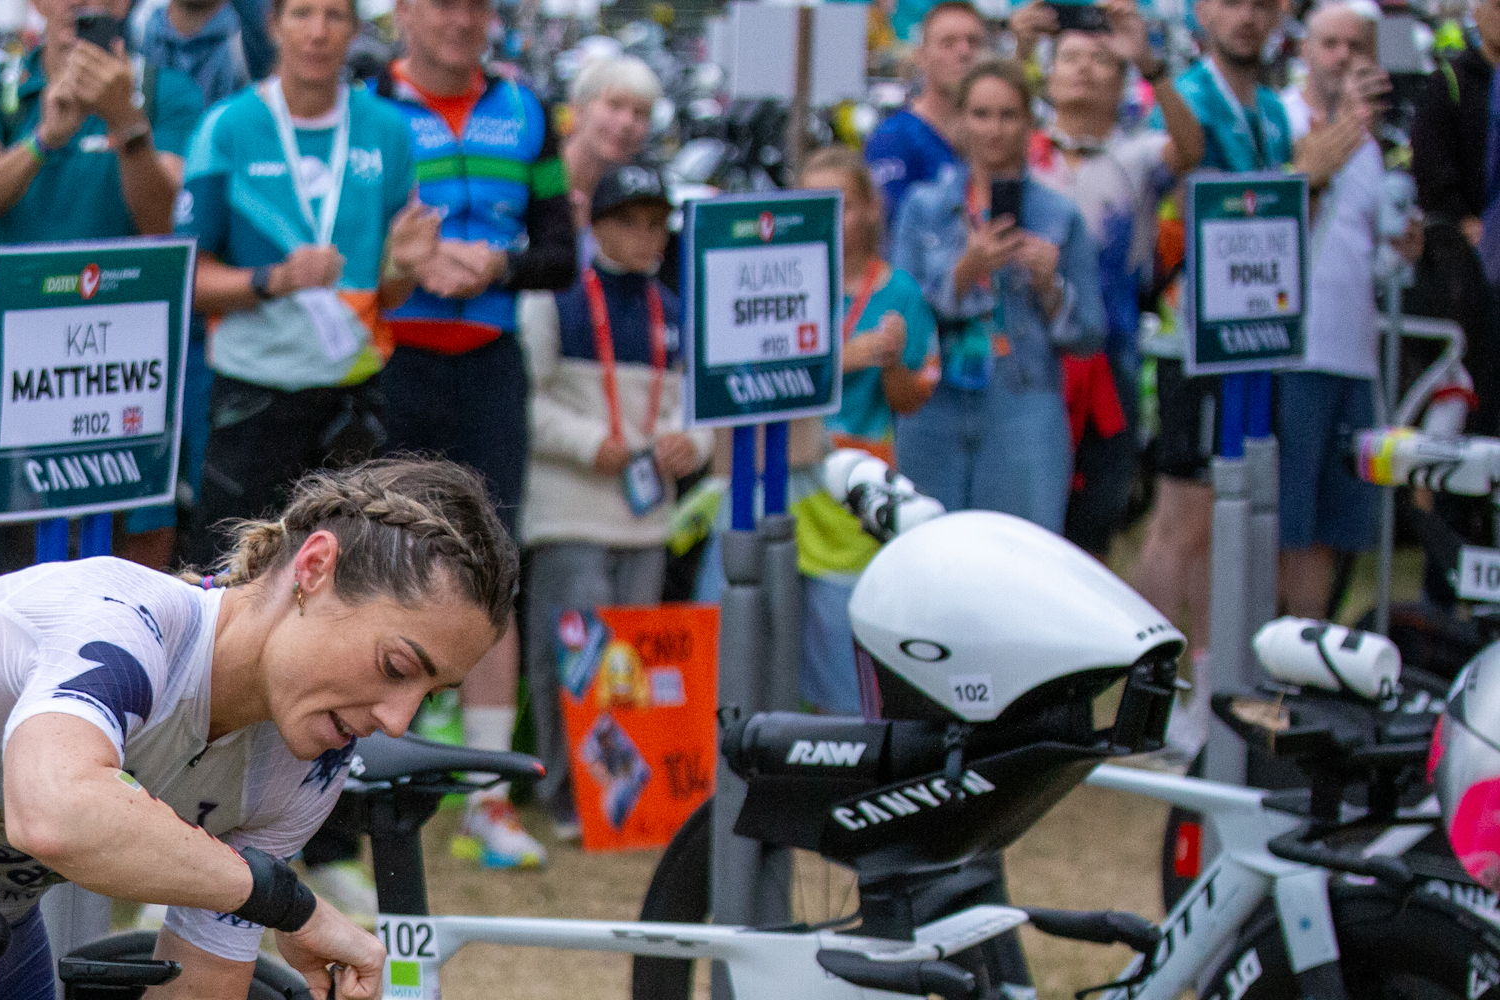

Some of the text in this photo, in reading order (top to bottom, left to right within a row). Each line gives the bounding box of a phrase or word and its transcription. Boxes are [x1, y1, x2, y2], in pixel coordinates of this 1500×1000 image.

[738, 261, 804, 289] ALANIS
[734, 293, 808, 326] SIFFERT
[66, 320, 112, 357] KAT
[11, 358, 163, 403] MATTHEWS
[71, 412, 111, 436] #102
[24, 450, 142, 493] CANYON
[1471, 562, 1500, 586] 10
[954, 683, 990, 703] 102
[786, 740, 868, 767] RAW
[380, 920, 436, 958] 102
